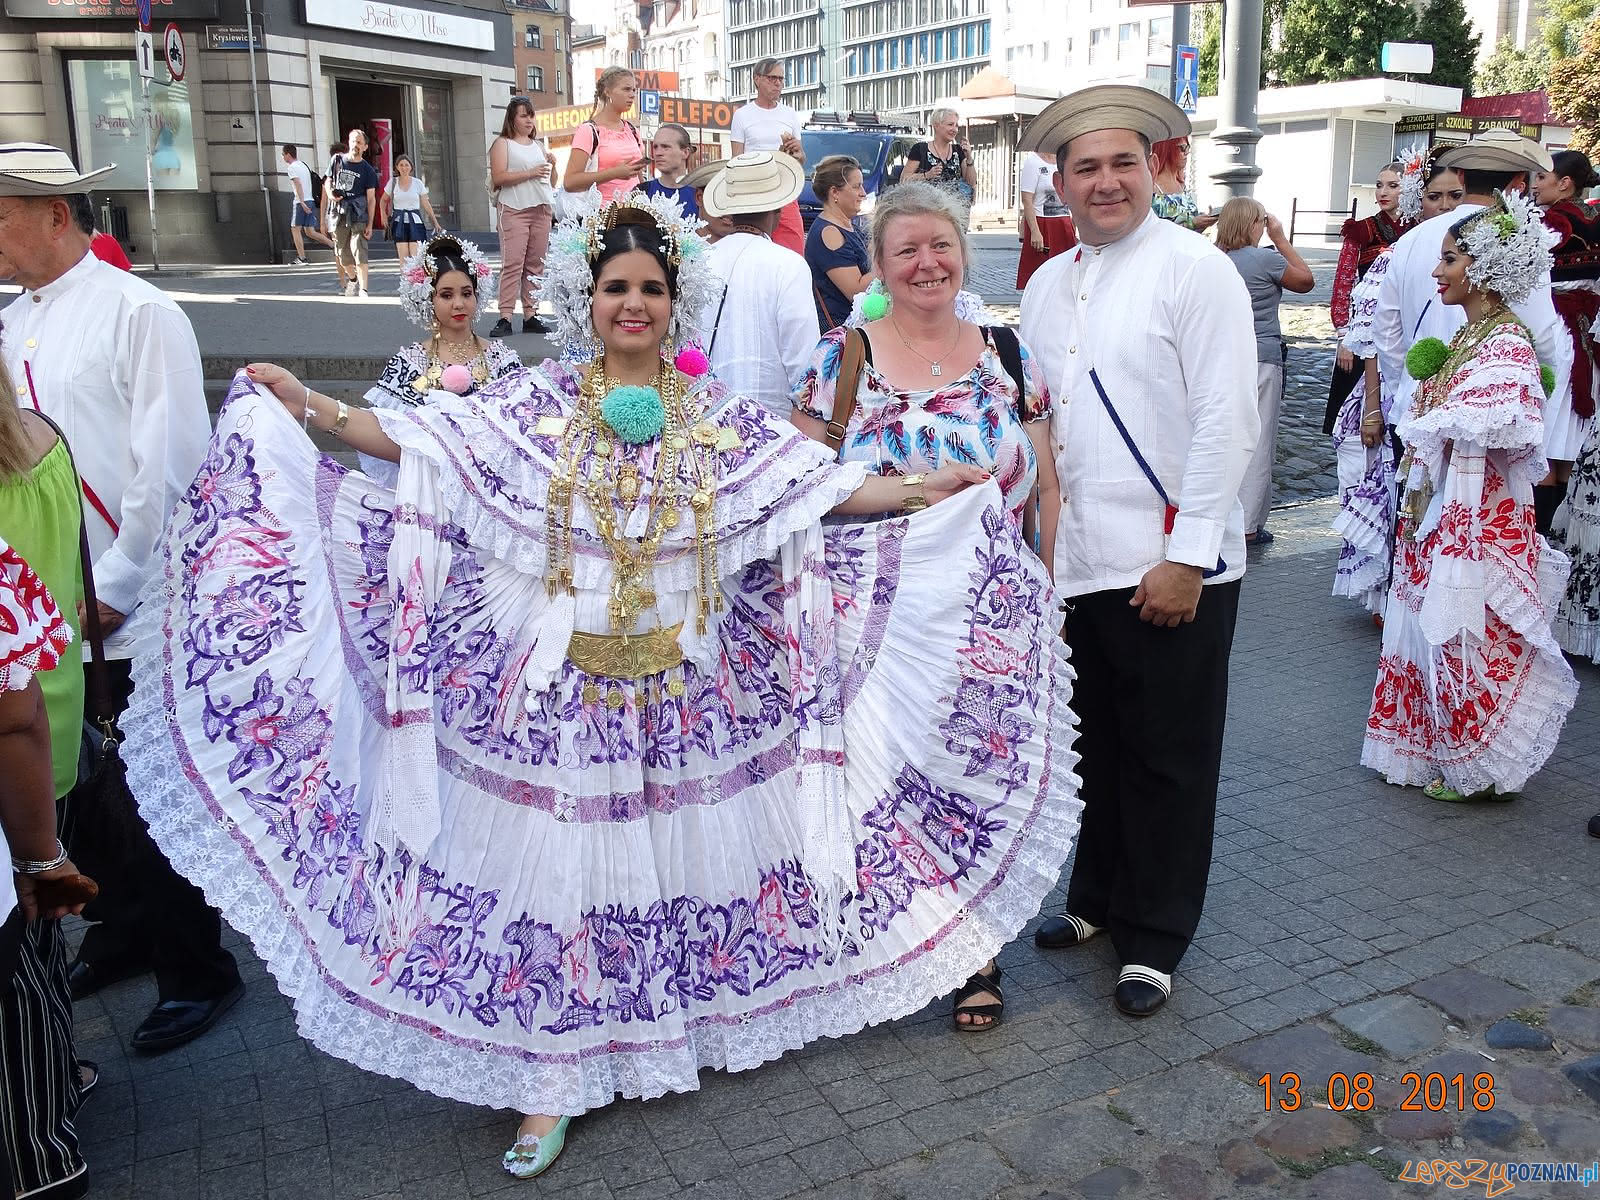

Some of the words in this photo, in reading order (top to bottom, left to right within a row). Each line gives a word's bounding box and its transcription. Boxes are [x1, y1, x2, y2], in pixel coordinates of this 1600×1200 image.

[115, 6, 138, 15] stor
[212, 33, 257, 43] Krysiewica
[645, 95, 657, 112] P
[663, 100, 737, 126] ELEFO
[1406, 114, 1435, 123] SZKOLNE
[1445, 117, 1473, 129] SZKOLNE
[1478, 120, 1520, 130] ZABAWKI
